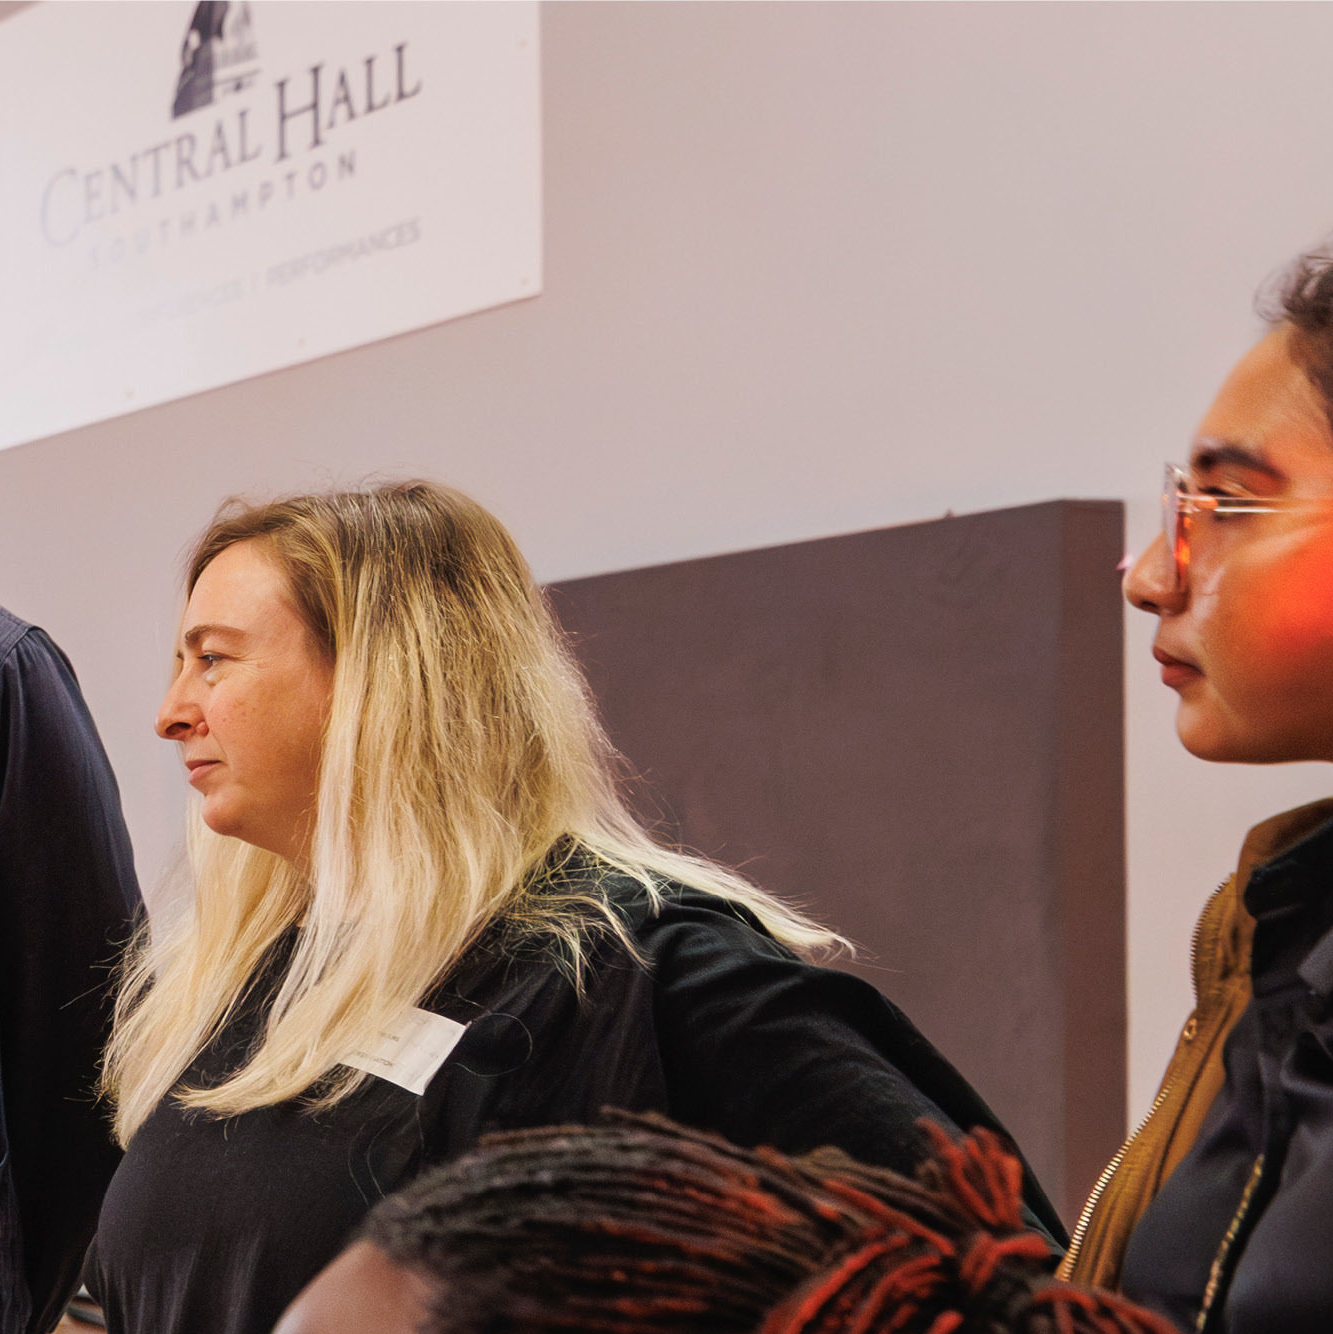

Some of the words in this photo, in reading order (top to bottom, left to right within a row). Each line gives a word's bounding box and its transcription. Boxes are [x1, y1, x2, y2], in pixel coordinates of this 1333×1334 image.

[40, 107, 262, 247] CENTRAL
[275, 41, 422, 164] HALL
[88, 150, 356, 269] SOUTHAMPTON
